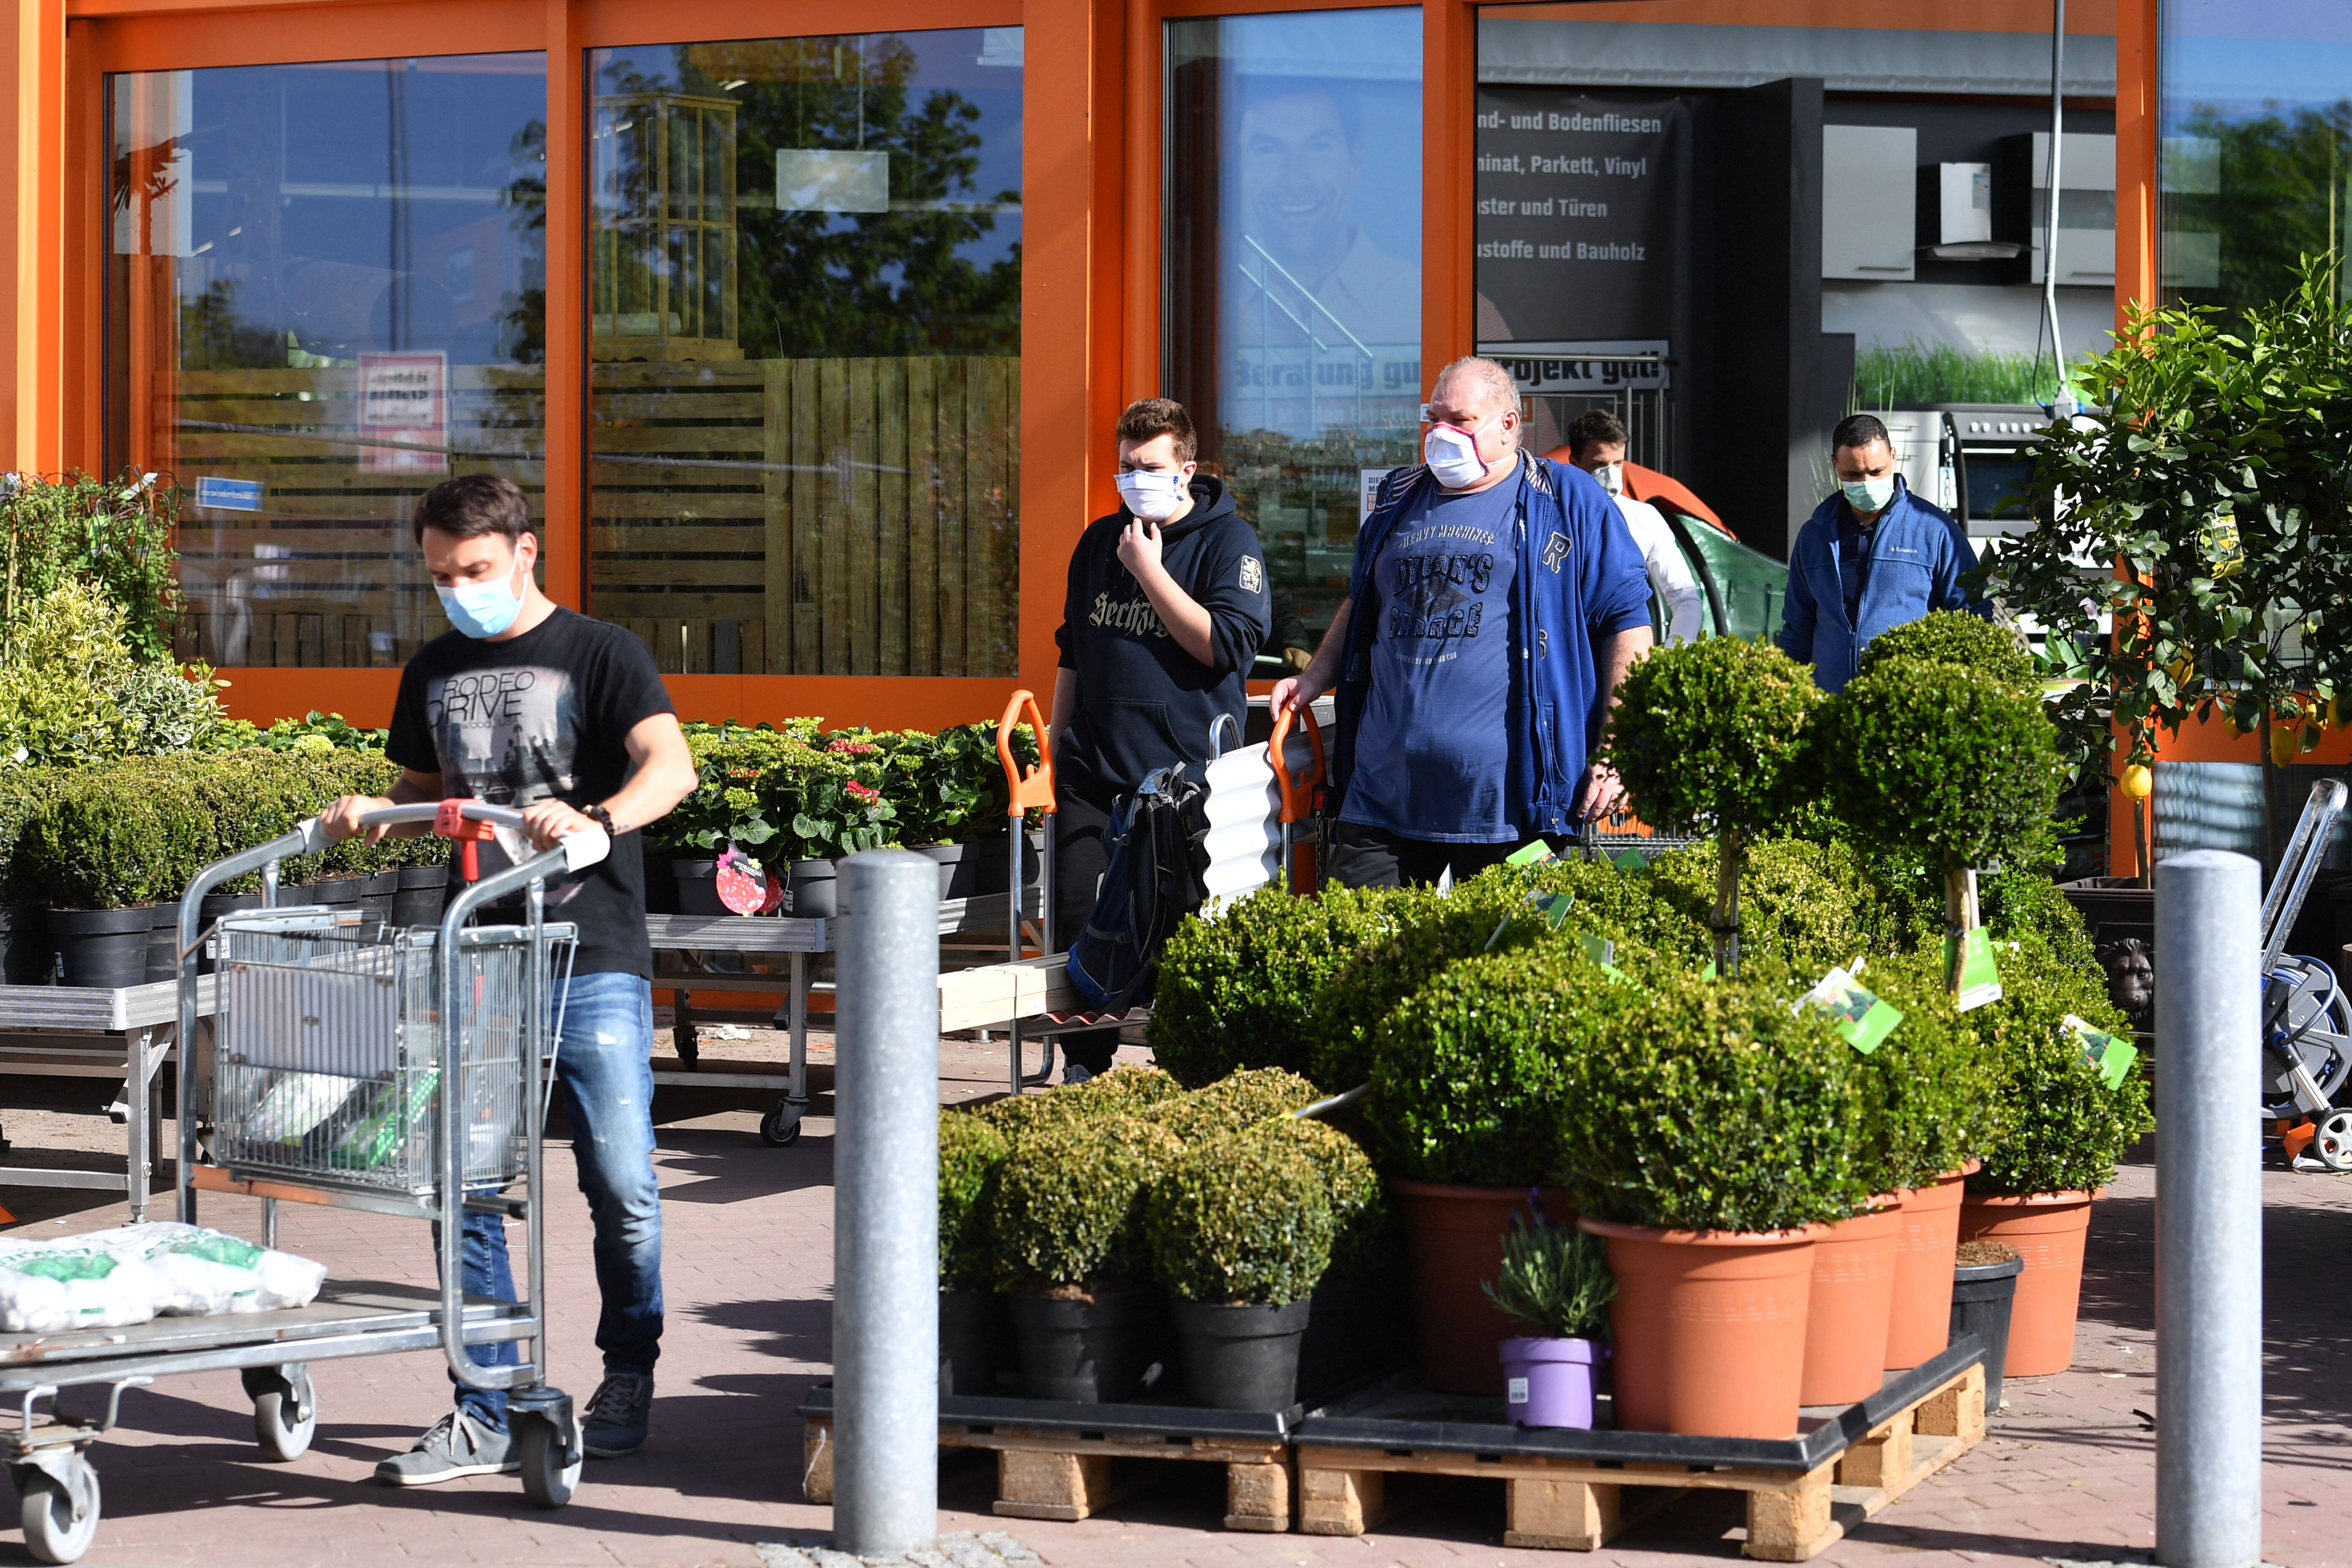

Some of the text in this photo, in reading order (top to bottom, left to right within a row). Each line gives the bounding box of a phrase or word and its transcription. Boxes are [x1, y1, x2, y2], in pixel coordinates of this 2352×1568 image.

[1511, 112, 1543, 130] und
[1548, 113, 1662, 133] Bodenfliesen
[1530, 155, 1600, 177] Parkett,
[1604, 157, 1647, 179] Vinyl
[1521, 198, 1553, 216] und
[1558, 199, 1608, 217] Türen
[1539, 241, 1571, 259] und
[1576, 242, 1645, 260] Bauholz
[1402, 524, 1494, 549] HEAVY MACHINES
[1393, 553, 1494, 596] DYLAN'S
[1388, 602, 1483, 639] GARAGE
[443, 671, 535, 698] RODEO
[429, 692, 522, 729] DRIVE
